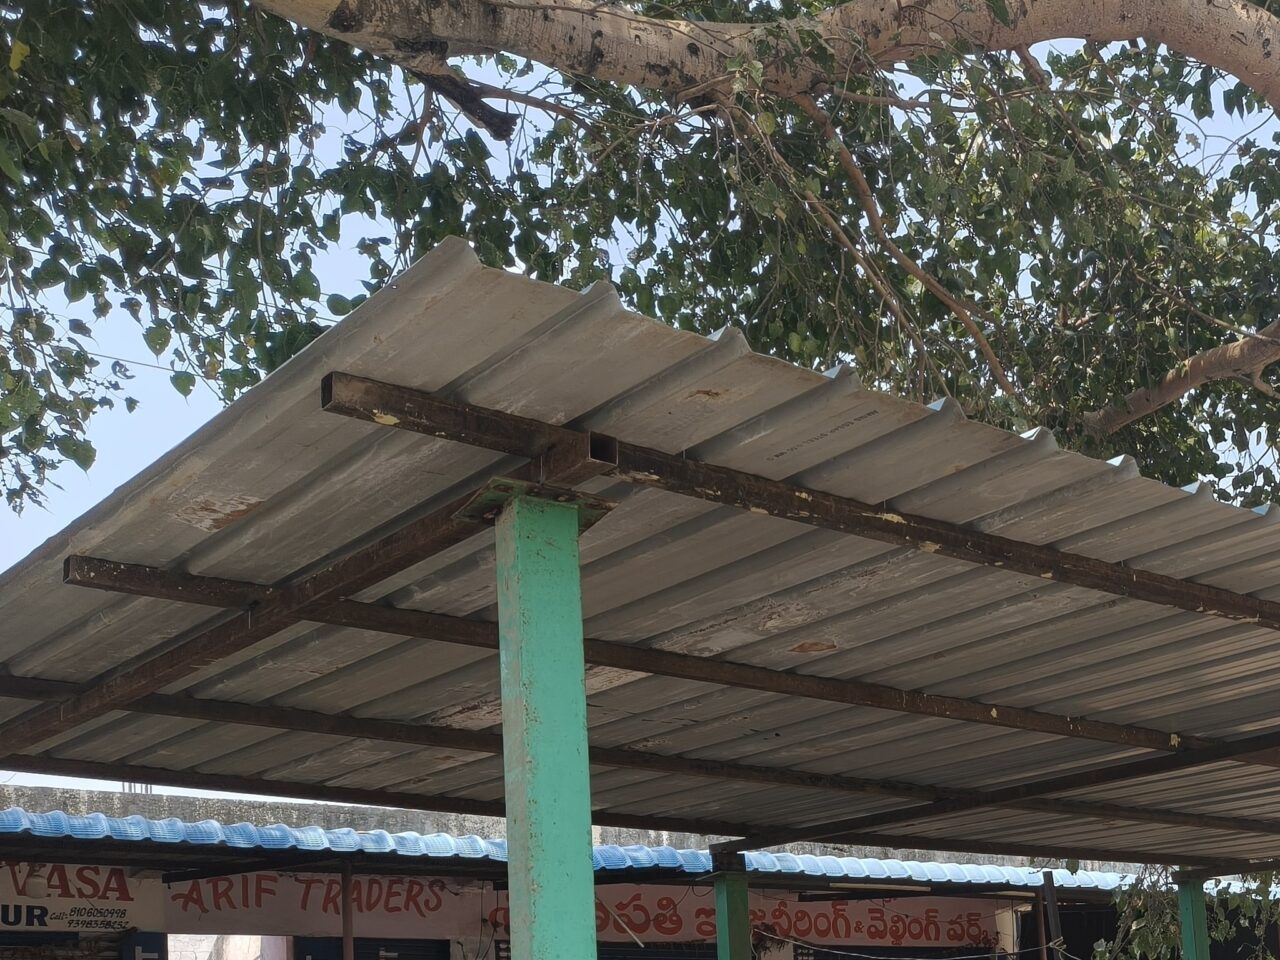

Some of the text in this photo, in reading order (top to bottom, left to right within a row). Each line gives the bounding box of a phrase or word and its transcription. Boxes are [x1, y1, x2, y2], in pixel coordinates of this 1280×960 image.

[171, 874, 445, 918] ARIF TRADERS
[854, 920, 865, 933] &
